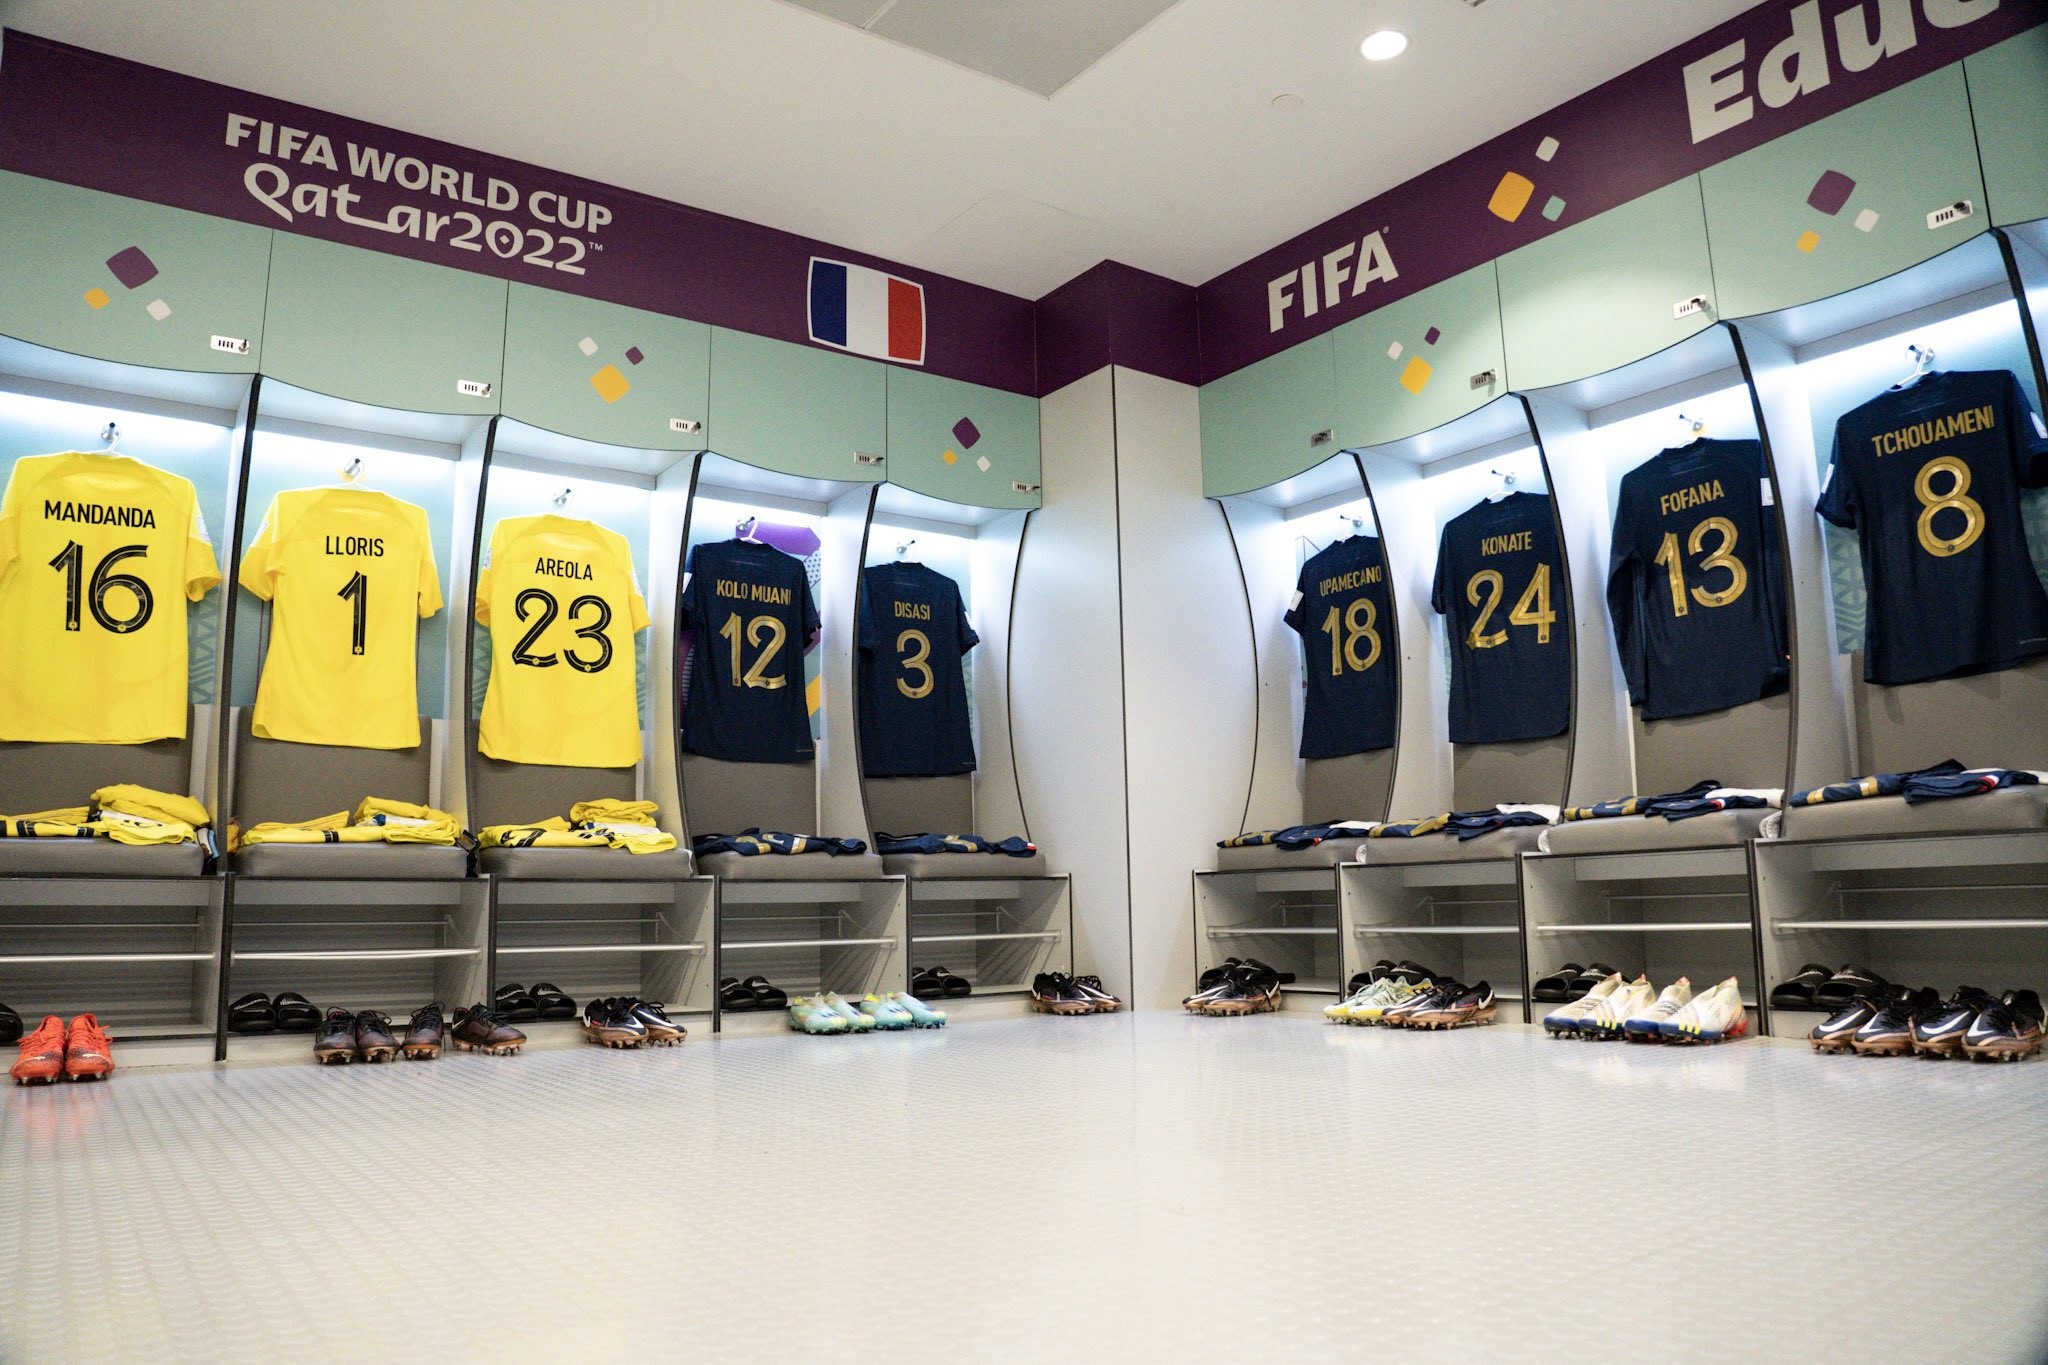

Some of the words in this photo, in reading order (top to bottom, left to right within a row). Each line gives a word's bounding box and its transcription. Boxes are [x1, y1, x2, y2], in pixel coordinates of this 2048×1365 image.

[225, 112, 339, 172] FIFA
[346, 142, 520, 212] WORLD
[528, 190, 613, 234] CUP
[1267, 230, 1399, 334] FIFA
[1871, 404, 1996, 458] TCHOUAMENI
[44, 499, 156, 529] MANDANDA
[1659, 479, 1726, 516] FOFANA
[1913, 455, 1986, 558] 8
[325, 535, 385, 557] LLORIS
[535, 557, 594, 581] AREOLA
[1320, 565, 1382, 597] UPAMECANO
[1481, 530, 1533, 557] KONATE
[1653, 516, 1748, 618] 13
[47, 539, 155, 634] 16
[336, 569, 368, 656] 1
[716, 578, 749, 600] KOLO
[751, 584, 792, 606] MUANI
[894, 600, 931, 621] DISASI
[1465, 562, 1557, 650] 24
[511, 587, 614, 674] 23
[719, 611, 788, 690] 12
[896, 628, 935, 699] 3
[1321, 597, 1382, 676] 18
